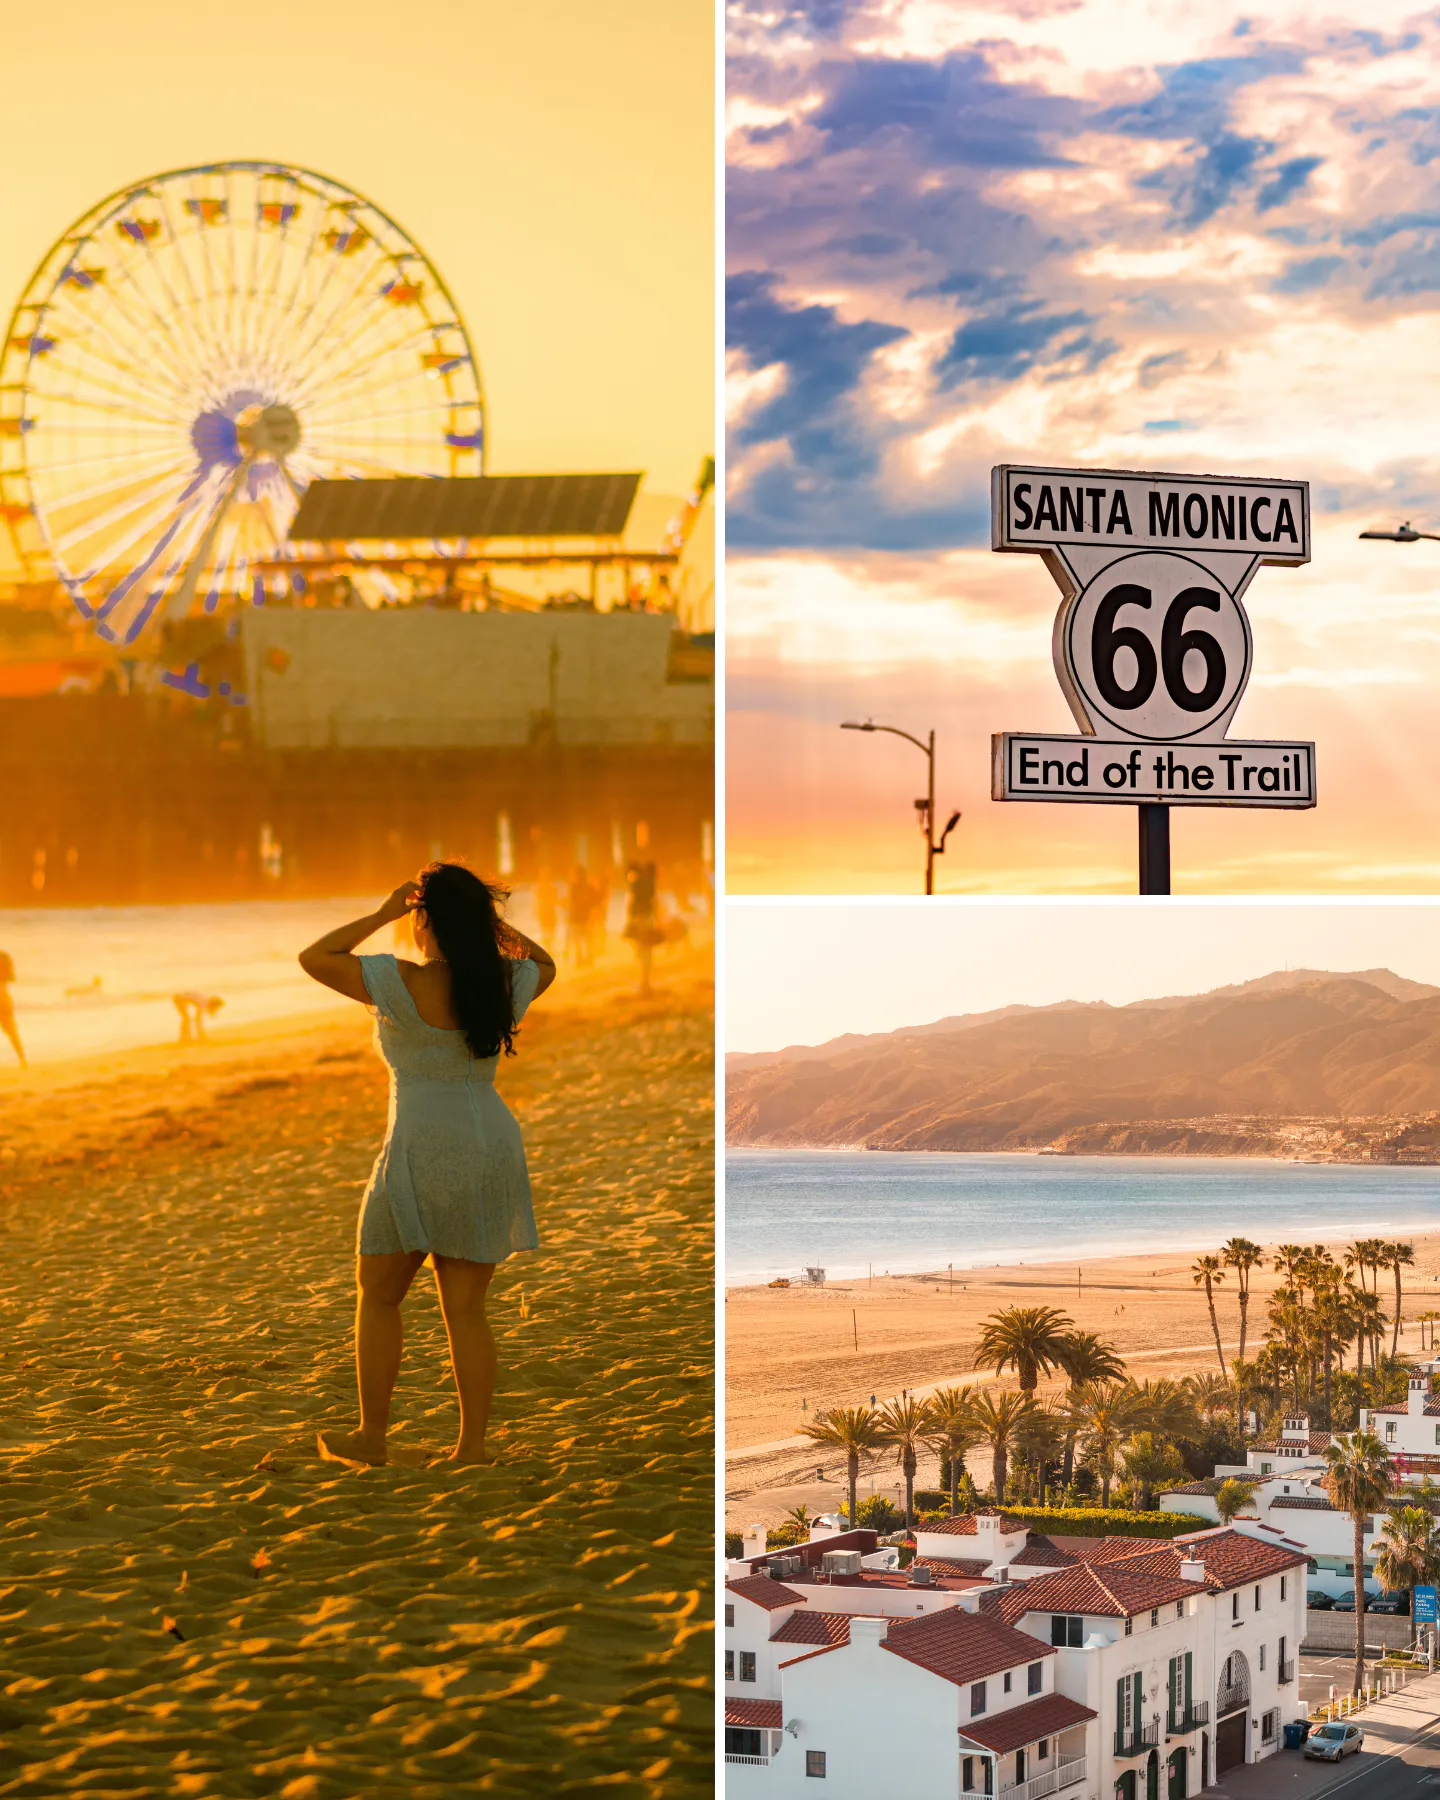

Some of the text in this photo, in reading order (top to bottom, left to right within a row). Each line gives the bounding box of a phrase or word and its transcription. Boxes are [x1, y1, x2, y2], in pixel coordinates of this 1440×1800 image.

[1013, 482, 1299, 544] SANTA MONICA
[1091, 583, 1227, 713] 66
[1019, 747, 1301, 792] End of the Trail
